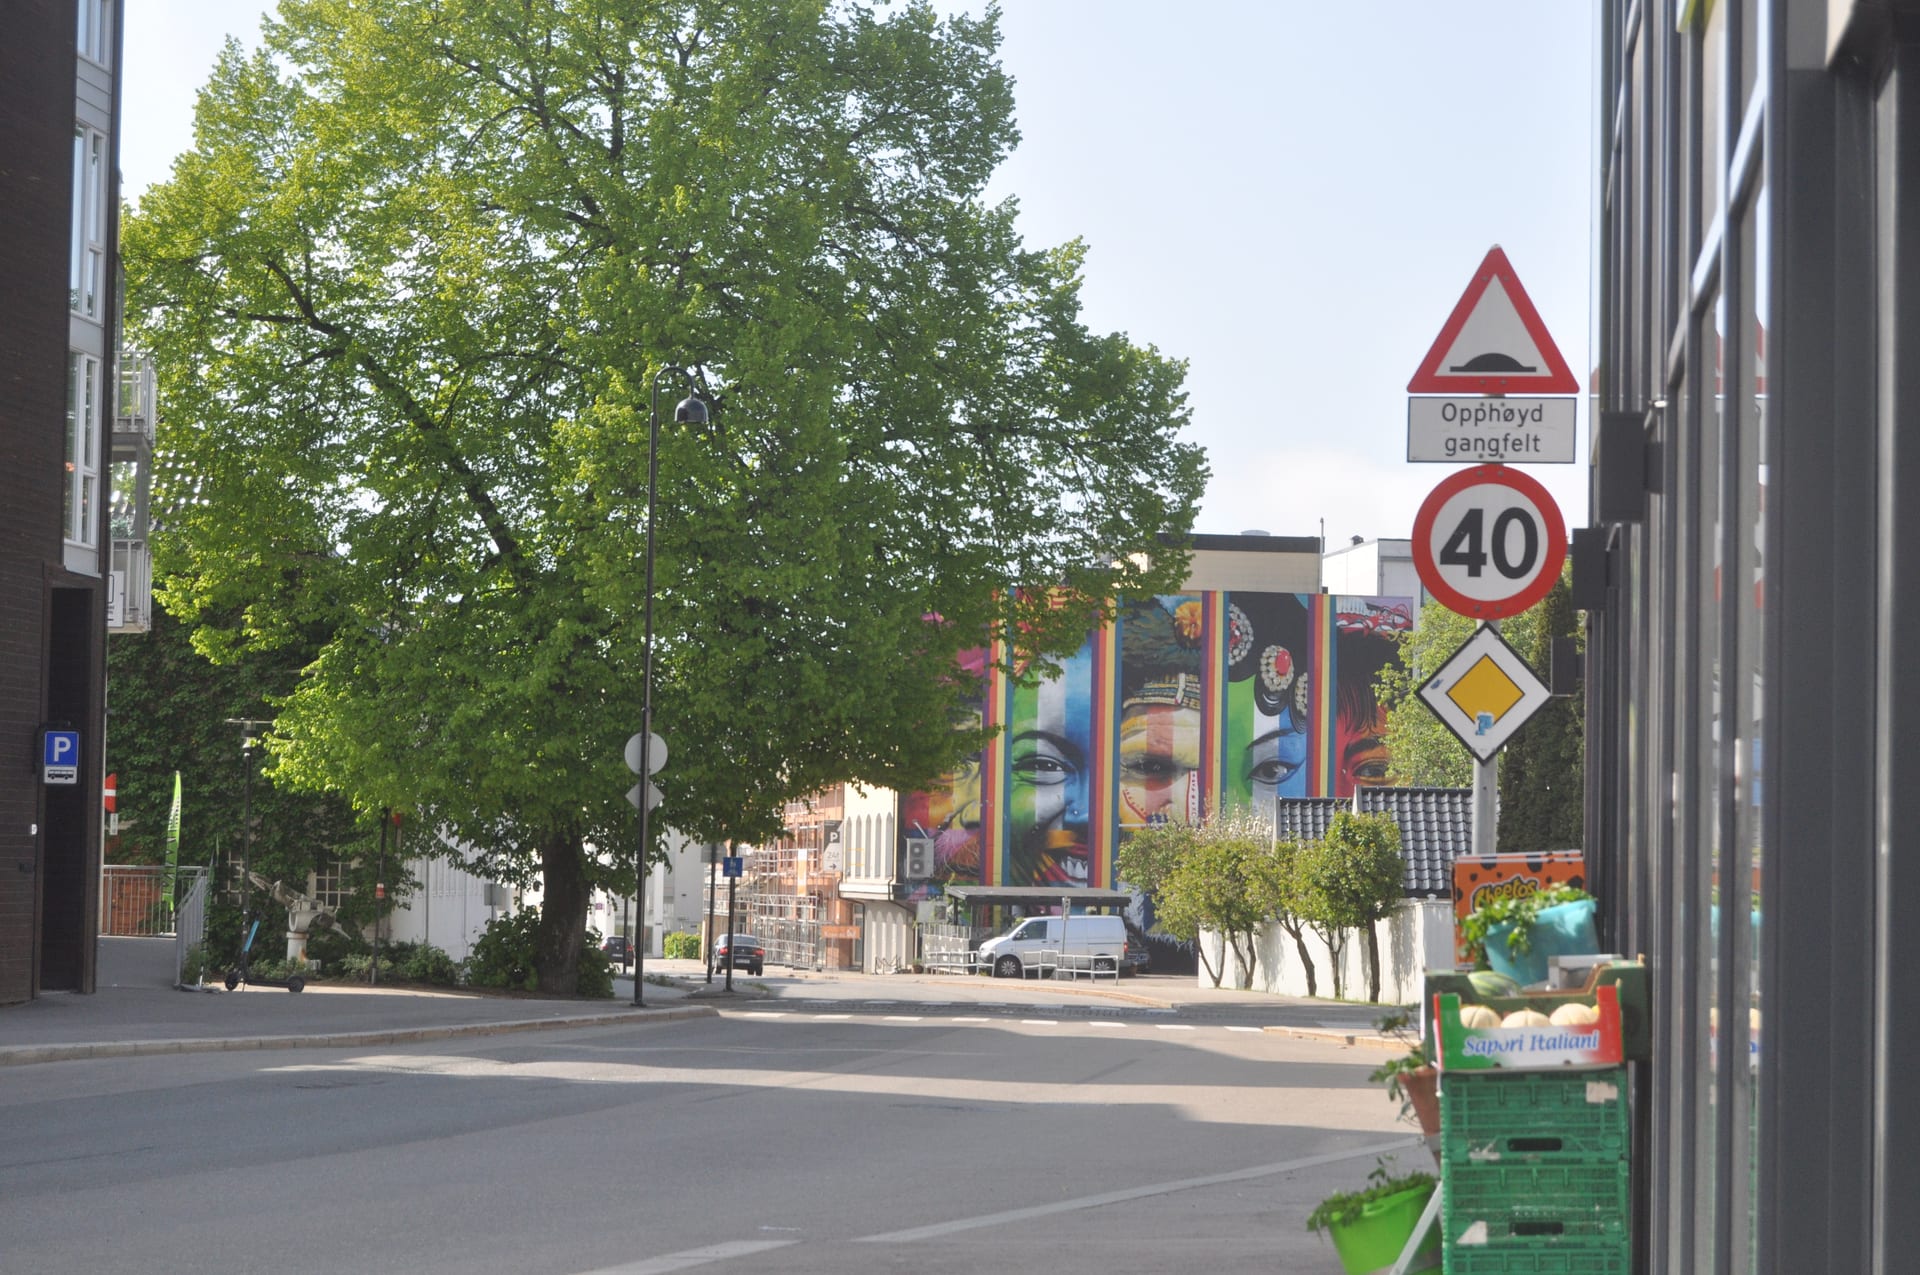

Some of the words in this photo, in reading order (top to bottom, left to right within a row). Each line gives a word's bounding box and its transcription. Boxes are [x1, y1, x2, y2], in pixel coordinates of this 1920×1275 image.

[1442, 402, 1543, 428] Opphøyd
[1445, 433, 1541, 458] gangfelt
[1440, 507, 1539, 580] 40
[54, 737, 72, 762] P
[830, 831, 839, 842] P
[1530, 1029, 1600, 1052] Italiani
